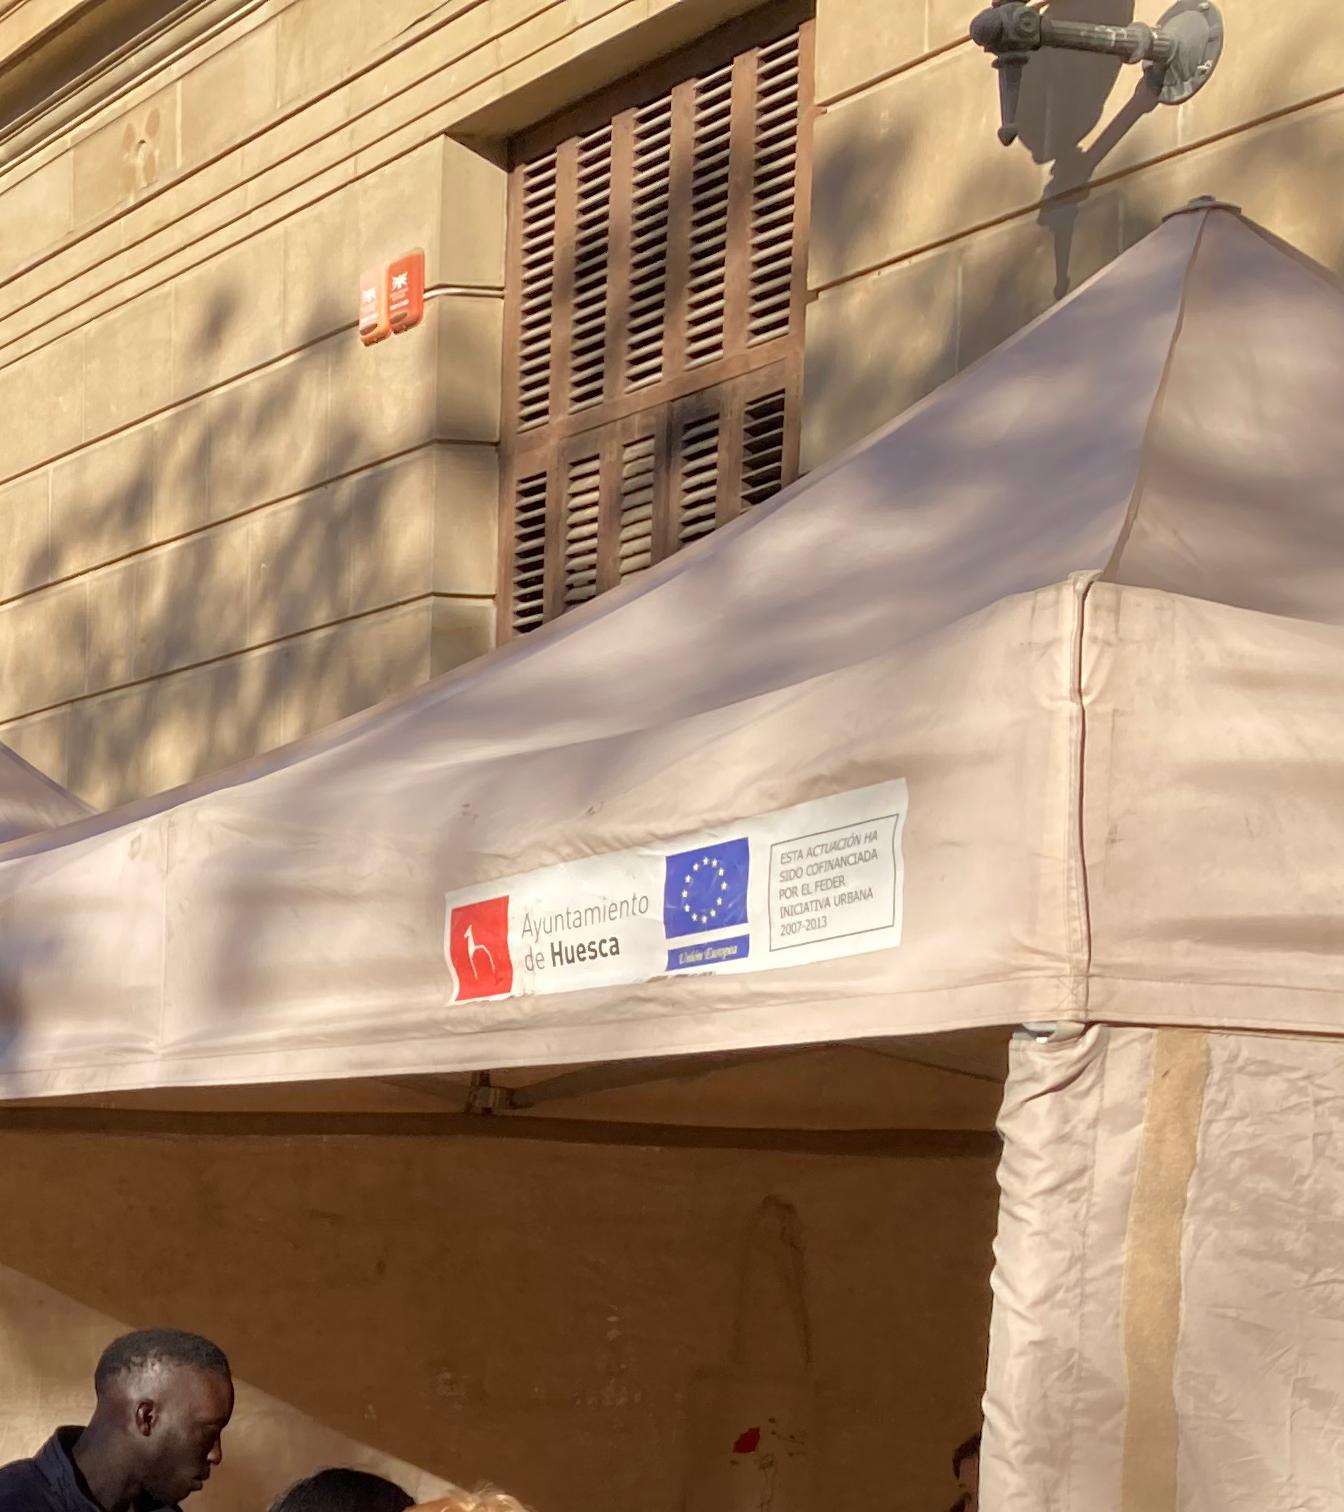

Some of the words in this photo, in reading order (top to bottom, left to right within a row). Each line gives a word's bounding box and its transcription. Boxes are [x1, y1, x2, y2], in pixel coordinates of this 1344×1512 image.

[780, 849, 804, 865] ESTA
[806, 832, 862, 858] ACTUACIÓN
[863, 829, 878, 844] HA
[779, 867, 804, 882] SIDO
[805, 848, 879, 877] COFINANCIADA
[778, 886, 799, 900] POR
[801, 882, 813, 896] EL
[814, 874, 847, 892] FEDER
[779, 896, 832, 919] INICIATIVA
[833, 887, 874, 907] URBANA
[521, 891, 649, 944] Ayuntamiento
[780, 915, 828, 937] 2007-2013
[524, 945, 545, 972] de
[550, 936, 620, 968] Huesca
